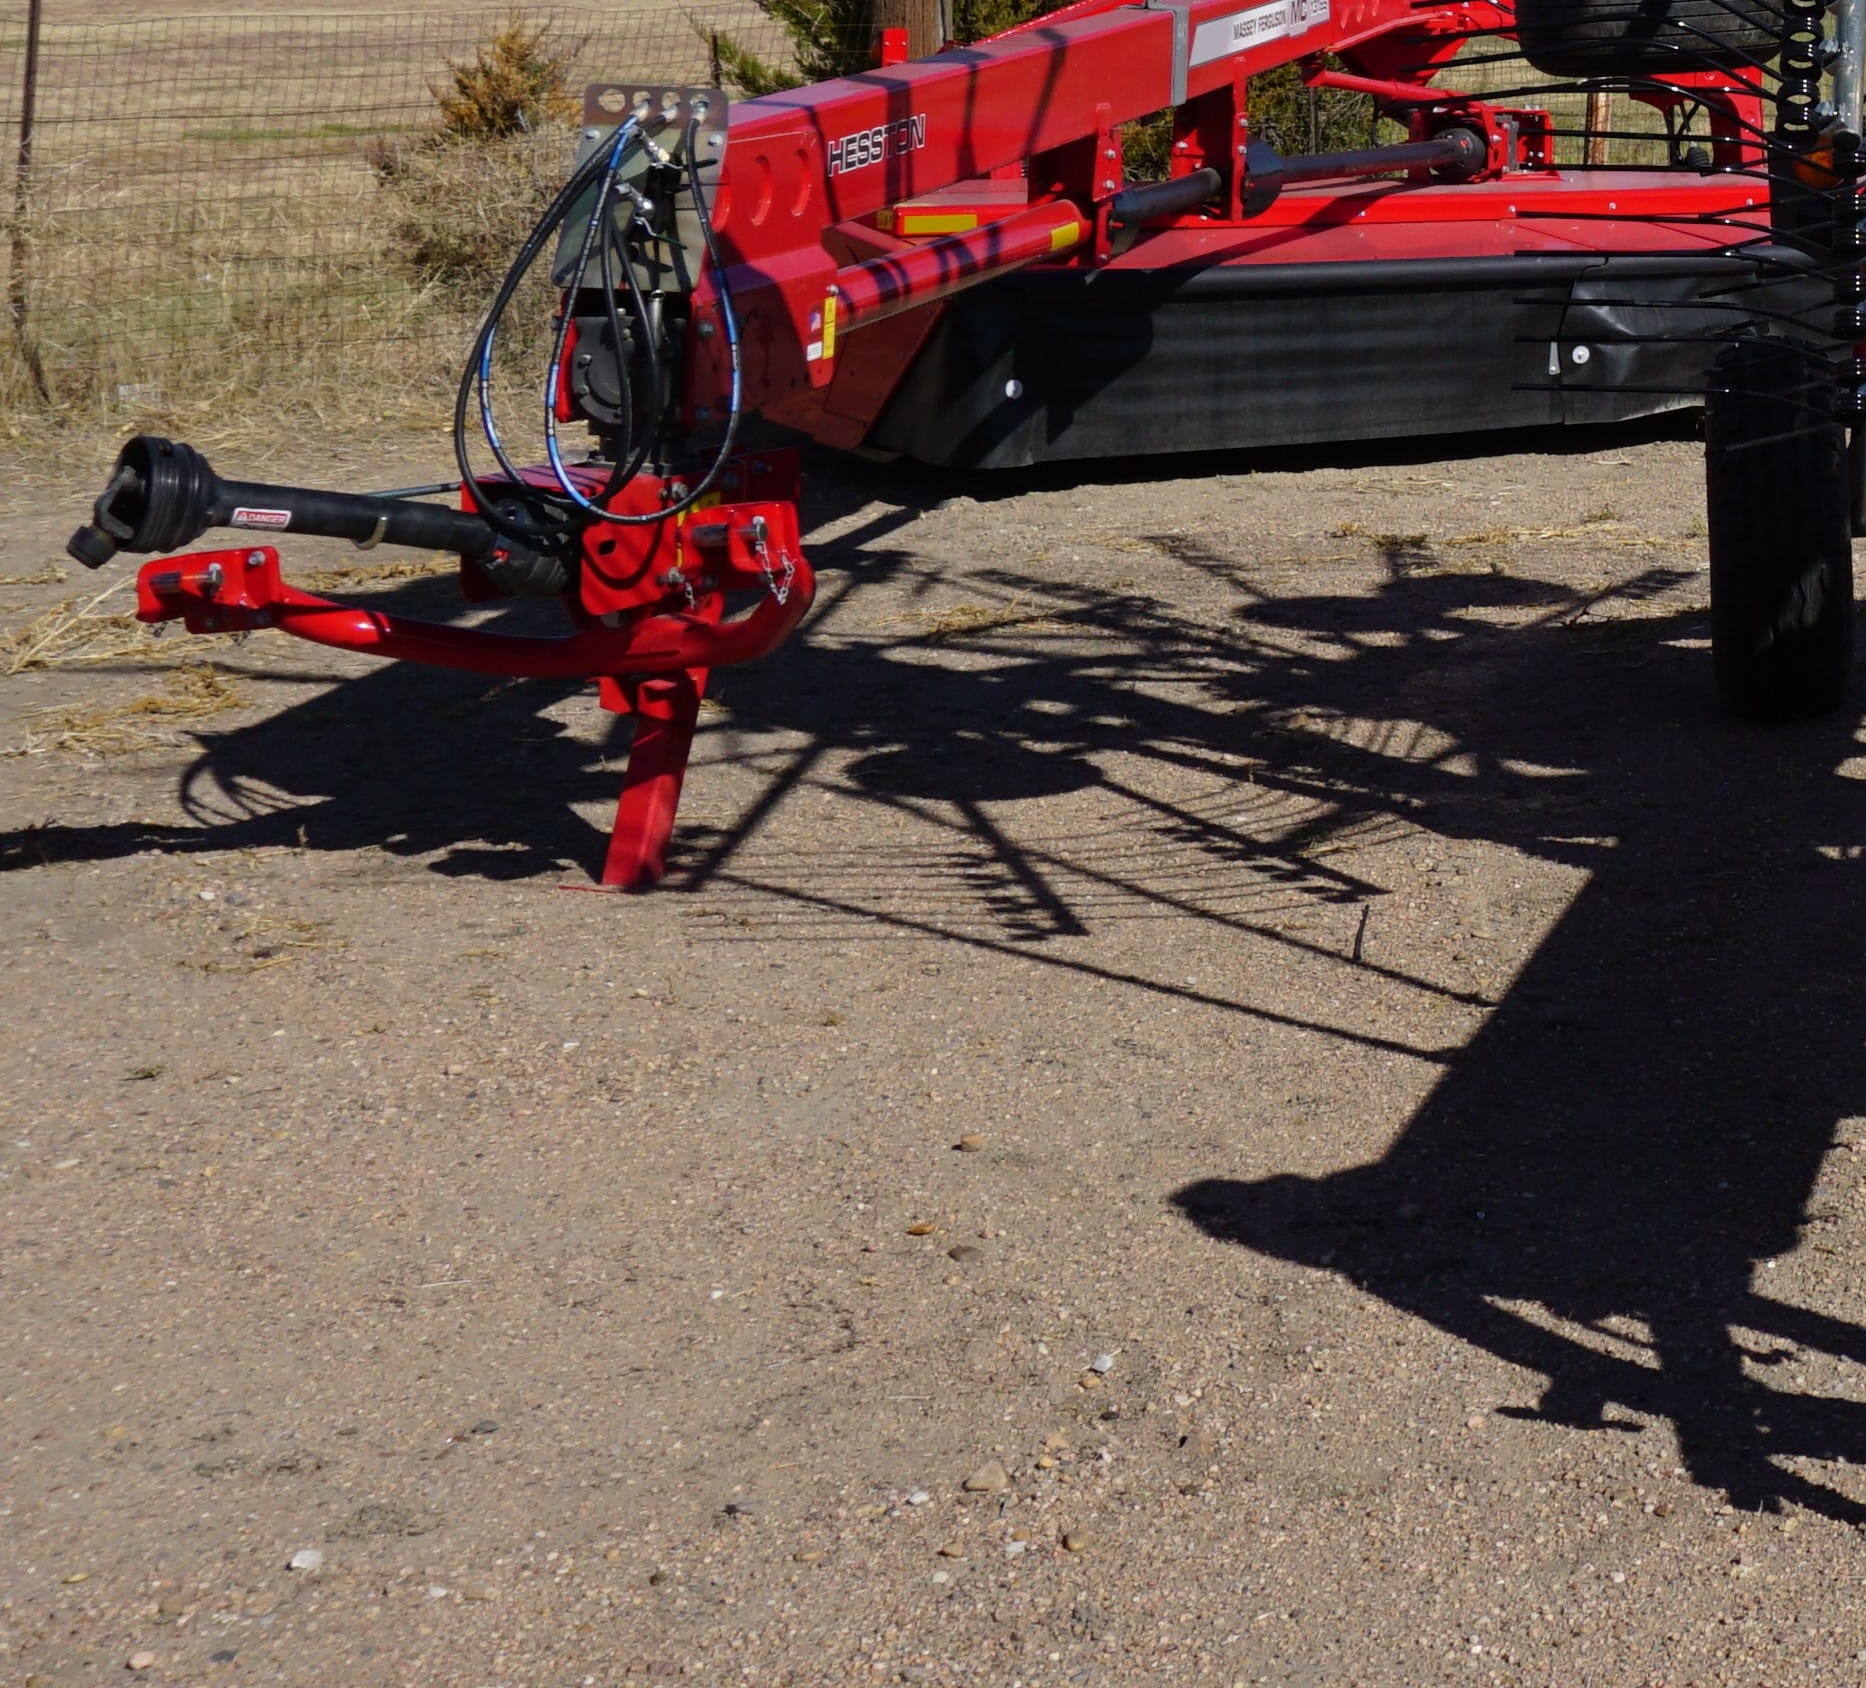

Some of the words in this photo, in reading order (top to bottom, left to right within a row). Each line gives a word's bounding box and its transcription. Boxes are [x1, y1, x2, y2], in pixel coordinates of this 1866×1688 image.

[1233, 18, 1257, 40] MASSEY
[1257, 8, 1287, 32] FERGUSON
[827, 113, 926, 177] HESSTON
